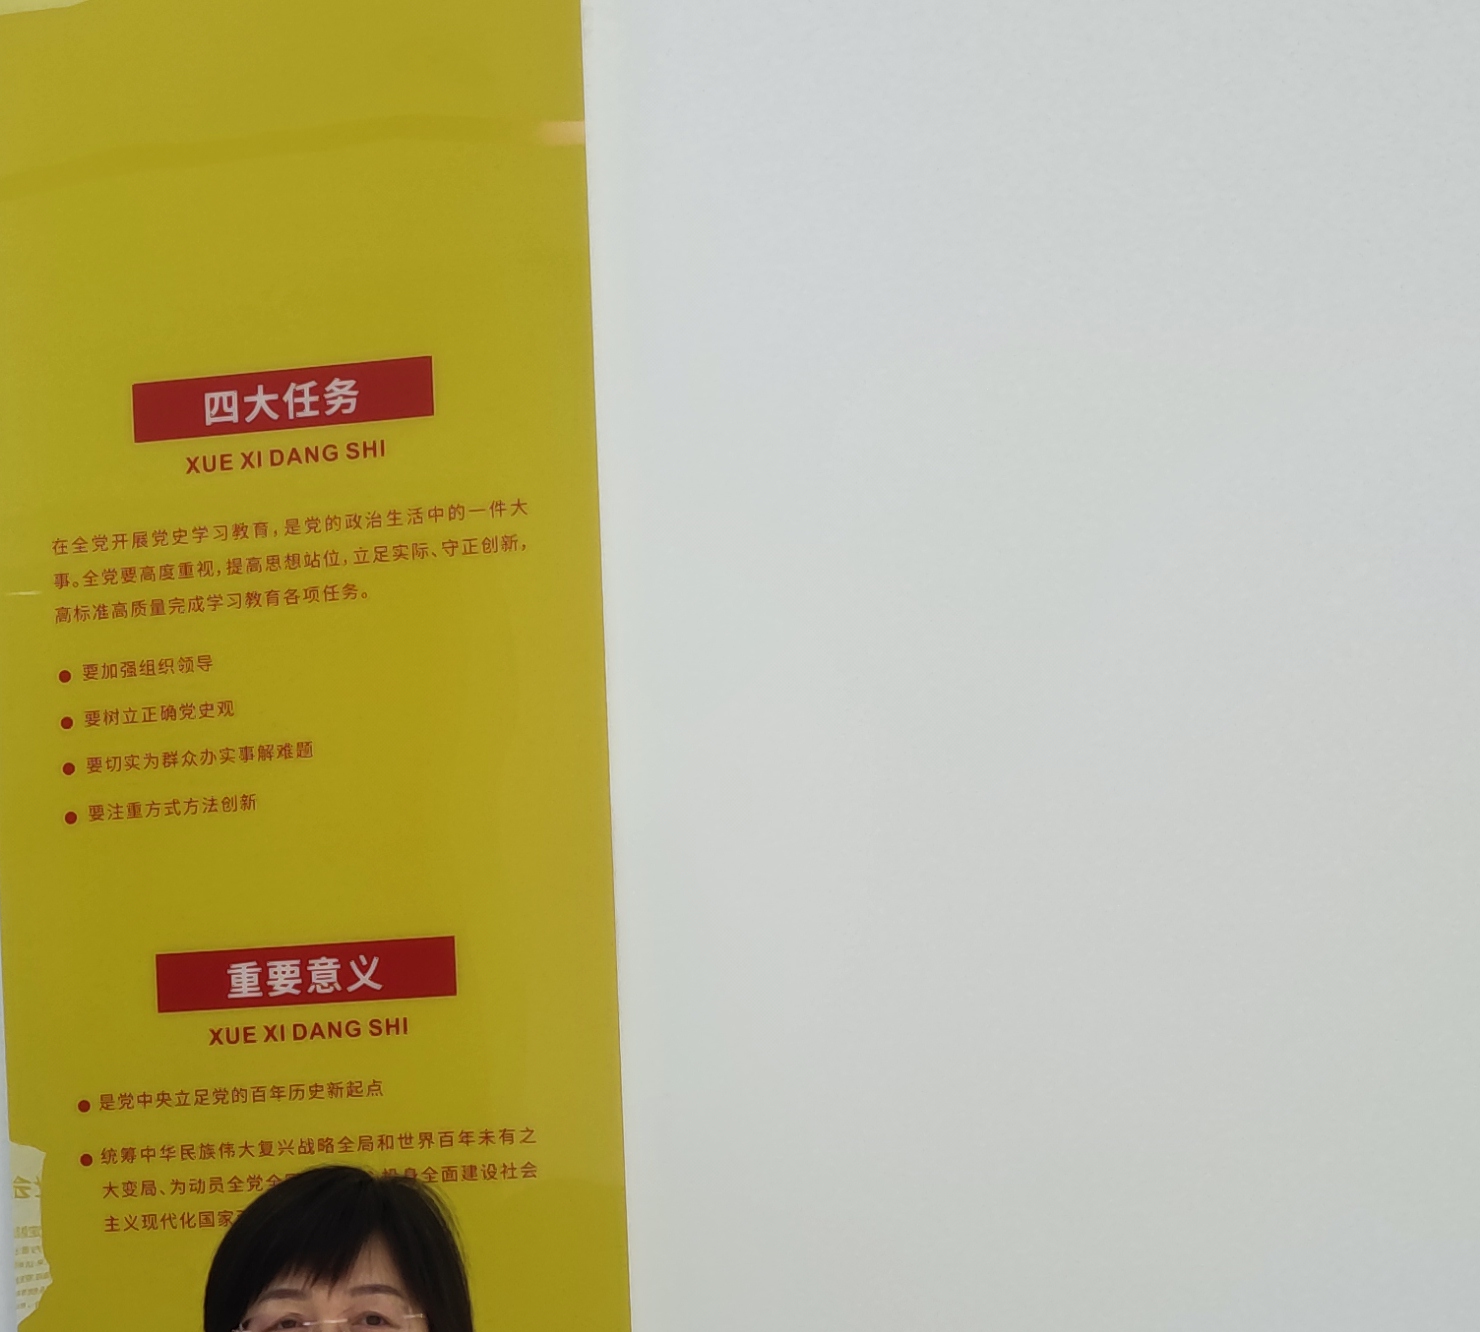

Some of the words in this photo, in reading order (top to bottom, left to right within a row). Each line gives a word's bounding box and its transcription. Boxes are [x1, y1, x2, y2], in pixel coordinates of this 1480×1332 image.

[204, 378, 360, 426] 四大任务
[185, 454, 233, 474] XUE
[240, 450, 263, 470] XI
[269, 443, 339, 467] DANG
[346, 440, 385, 460] SHI
[83, 654, 213, 681] 要加强组织领导
[85, 700, 234, 727] 要树立正确党史观
[86, 741, 313, 774] 要切实为群众办实事解难题
[88, 794, 256, 822] 要注重方式方法创新
[227, 955, 382, 999] 重要意义
[209, 1026, 256, 1046] XUE
[263, 1023, 286, 1043] XI
[293, 1019, 362, 1042] DANG
[369, 1016, 409, 1037] SHI
[99, 1079, 383, 1111] 是党中央立足党的百年历史新起点
[100, 1127, 536, 1165] 统筹中华民族伟大复兴战略全局和世界百年未有之
[104, 1208, 246, 1233] 主义现代化国家
